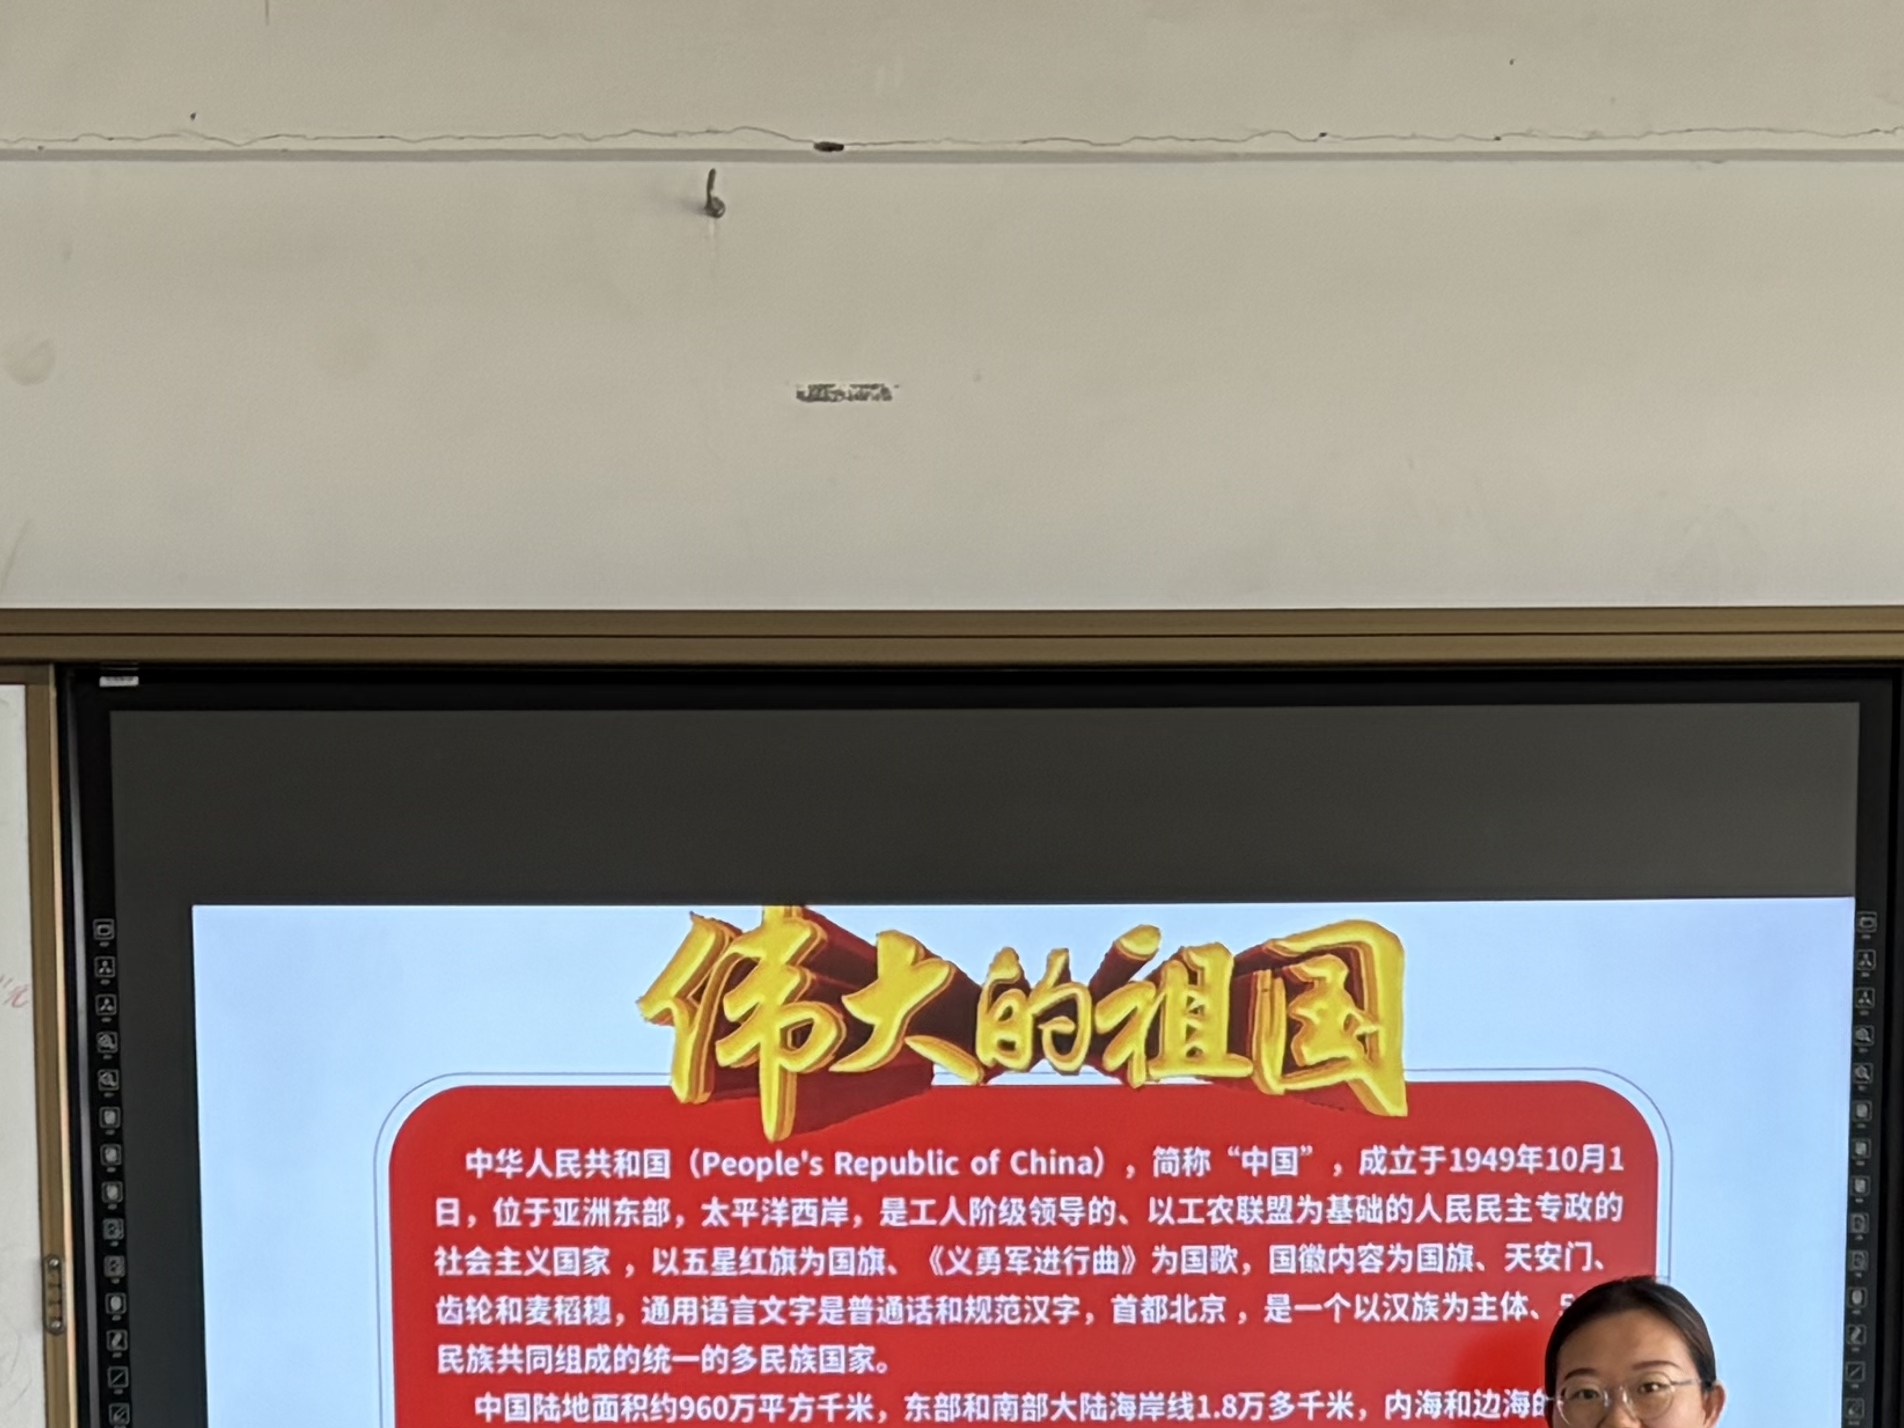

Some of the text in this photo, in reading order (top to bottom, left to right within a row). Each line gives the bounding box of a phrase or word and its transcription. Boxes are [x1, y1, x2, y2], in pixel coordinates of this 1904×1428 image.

[637, 905, 1408, 1142] 伟大的祖国
[834, 1148, 959, 1181] Republic
[970, 1148, 1000, 1176] of
